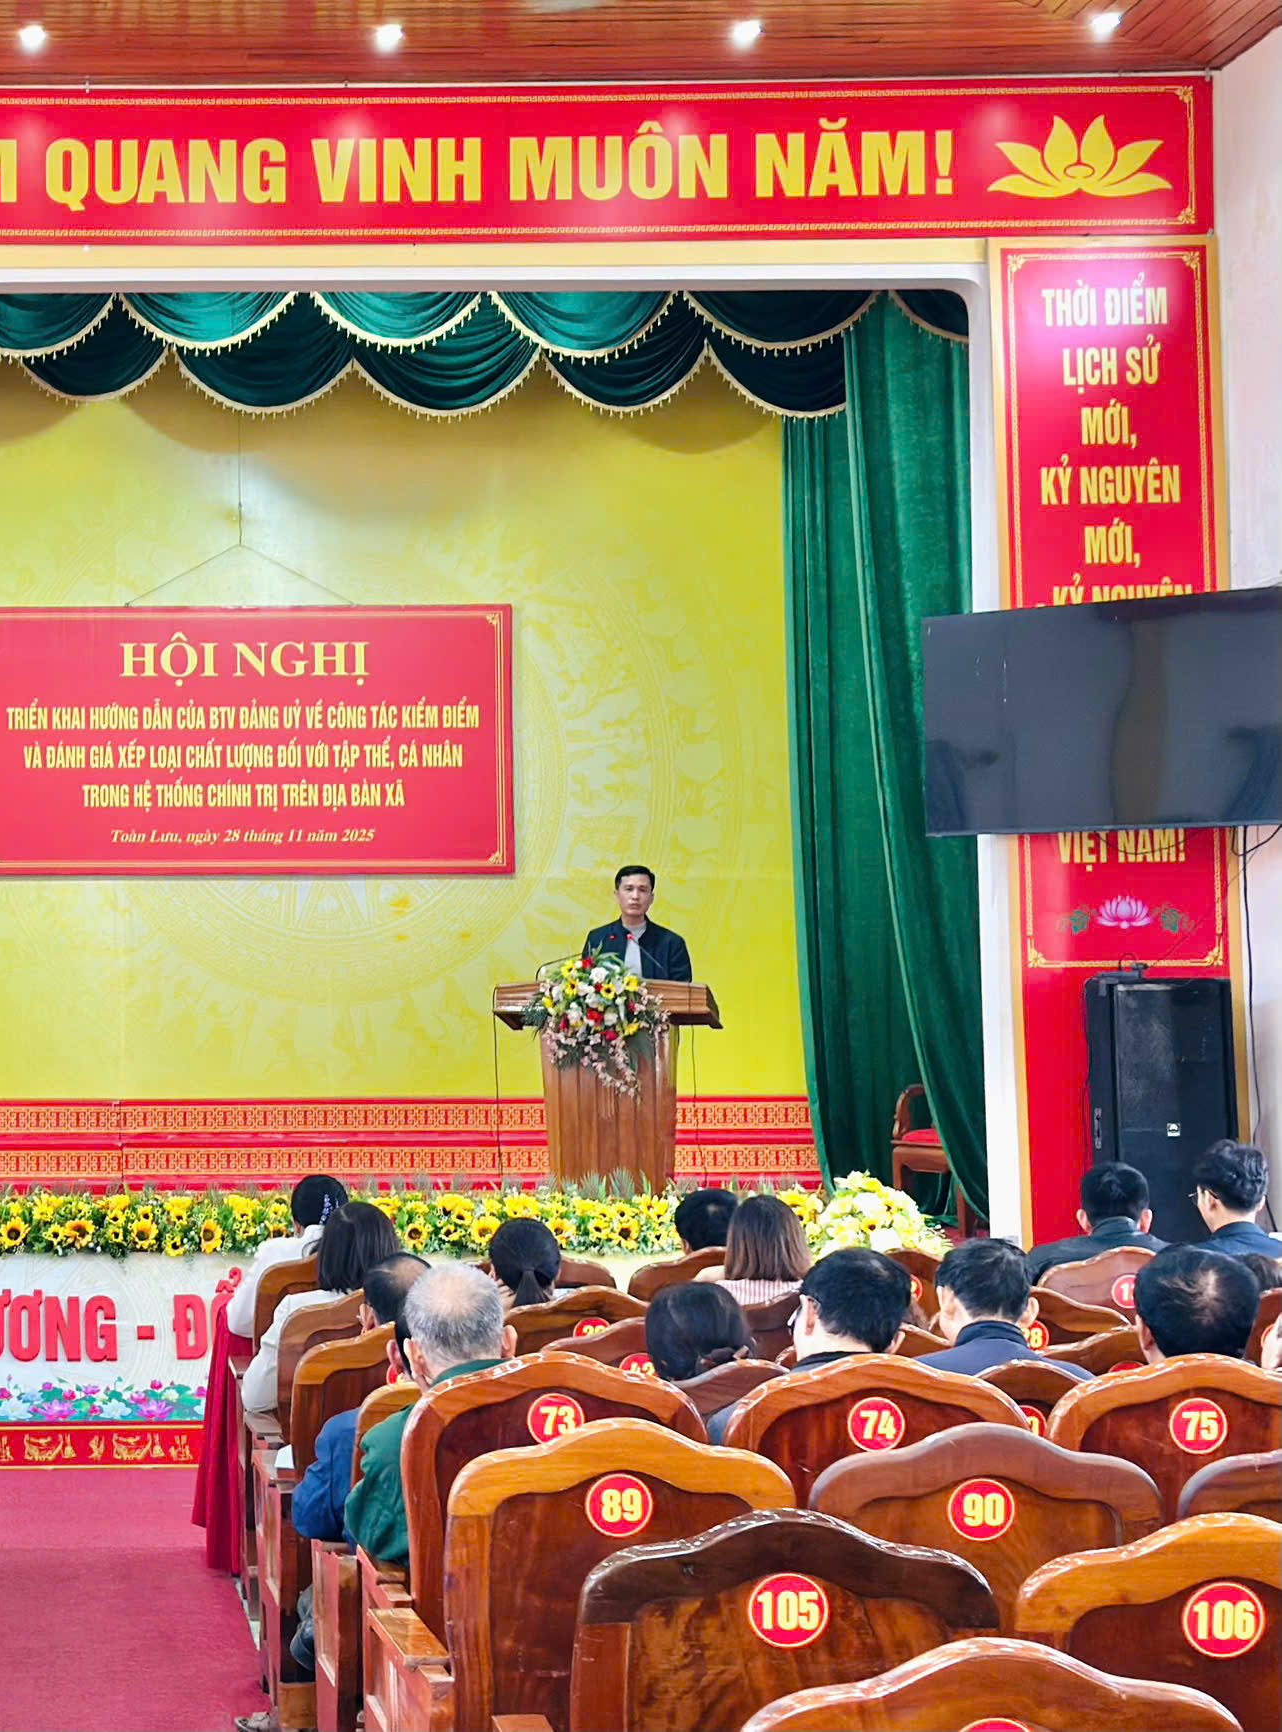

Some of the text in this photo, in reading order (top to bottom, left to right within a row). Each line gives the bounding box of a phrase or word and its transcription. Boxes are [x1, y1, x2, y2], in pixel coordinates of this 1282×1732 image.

[45, 137, 287, 212] QUANG
[311, 136, 482, 204] VINH
[508, 119, 728, 202] MUÔN
[755, 116, 954, 199] NĂM!
[1041, 271, 1168, 327] THỜI ĐIỂM
[1061, 332, 1162, 394] LỊCH SỬ
[1080, 398, 1137, 449] MỚI,
[1040, 453, 1181, 505] KỶ NGUYÊN
[1084, 517, 1141, 569] MỚI,
[120, 631, 369, 687] HỘI NGHỊ
[6, 695, 480, 730] TRIỂN KHAI HƯỚNG DẪN CỦA BTV ĐẢNG UỶ VỀ CÔNG TÁC KIỂM ĐIỂM
[23, 735, 463, 774] VÀ ĐÁNH GIÁ XẾP LOẠI CHẤT LƯỢNG ĐỐI VỚI TẬP THỂ, CÁ NHÂN
[81, 776, 405, 813] TRONG HỆ THỐNG CHÍNH TRỊ TRÊN ĐỊA BÀN XÃ
[111, 828, 375, 846] Toàn Lưu, ngày 28 tháng 11 năm 2025
[1118, 829, 1186, 863] NAM!
[539, 1405, 577, 1435] 73
[859, 1409, 897, 1440] 74
[1181, 1410, 1219, 1441] 75
[601, 1487, 643, 1523] 89
[963, 1492, 1005, 1527] 90
[756, 1590, 820, 1631] 105
[1192, 1599, 1256, 1641] 106
